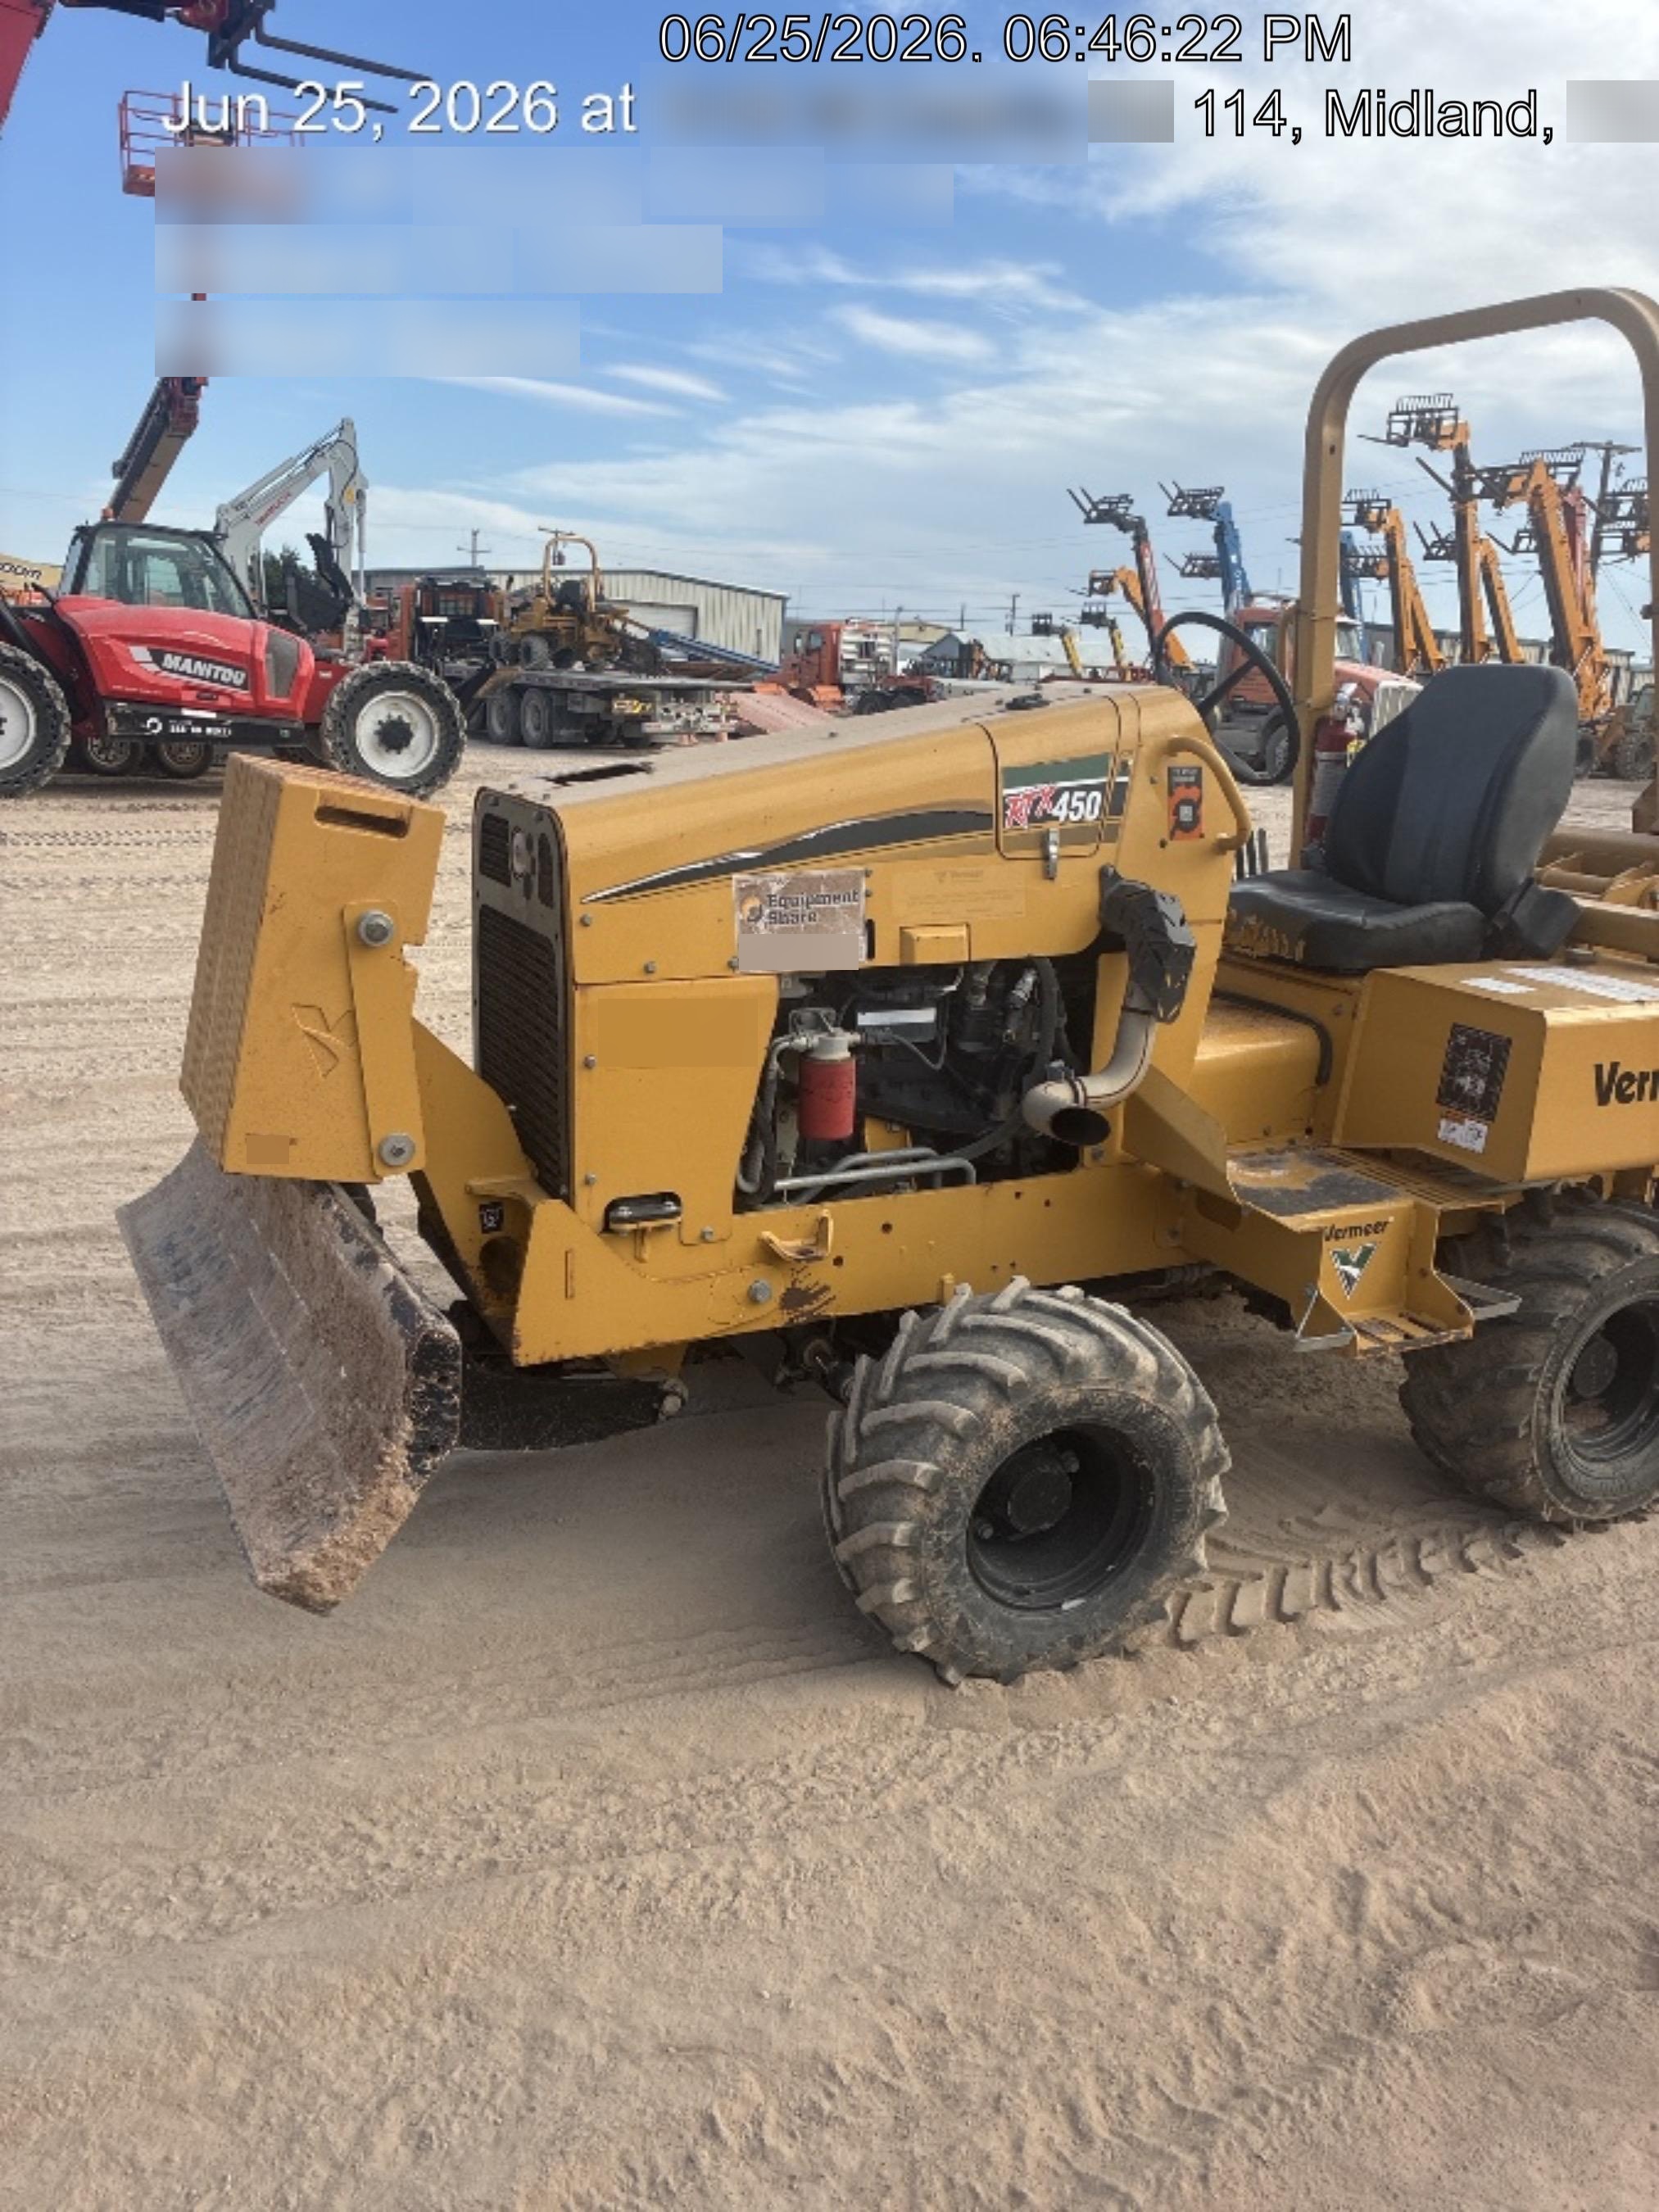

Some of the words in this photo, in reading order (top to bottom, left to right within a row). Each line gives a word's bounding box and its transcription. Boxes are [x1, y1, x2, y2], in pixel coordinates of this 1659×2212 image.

[161, 653, 247, 687] MANITOU
[1005, 784, 1057, 829] RTX
[1051, 790, 1103, 822] 450
[767, 890, 859, 909] Equipment
[768, 910, 818, 926] Share
[1324, 1221, 1389, 1241] Vermeer
